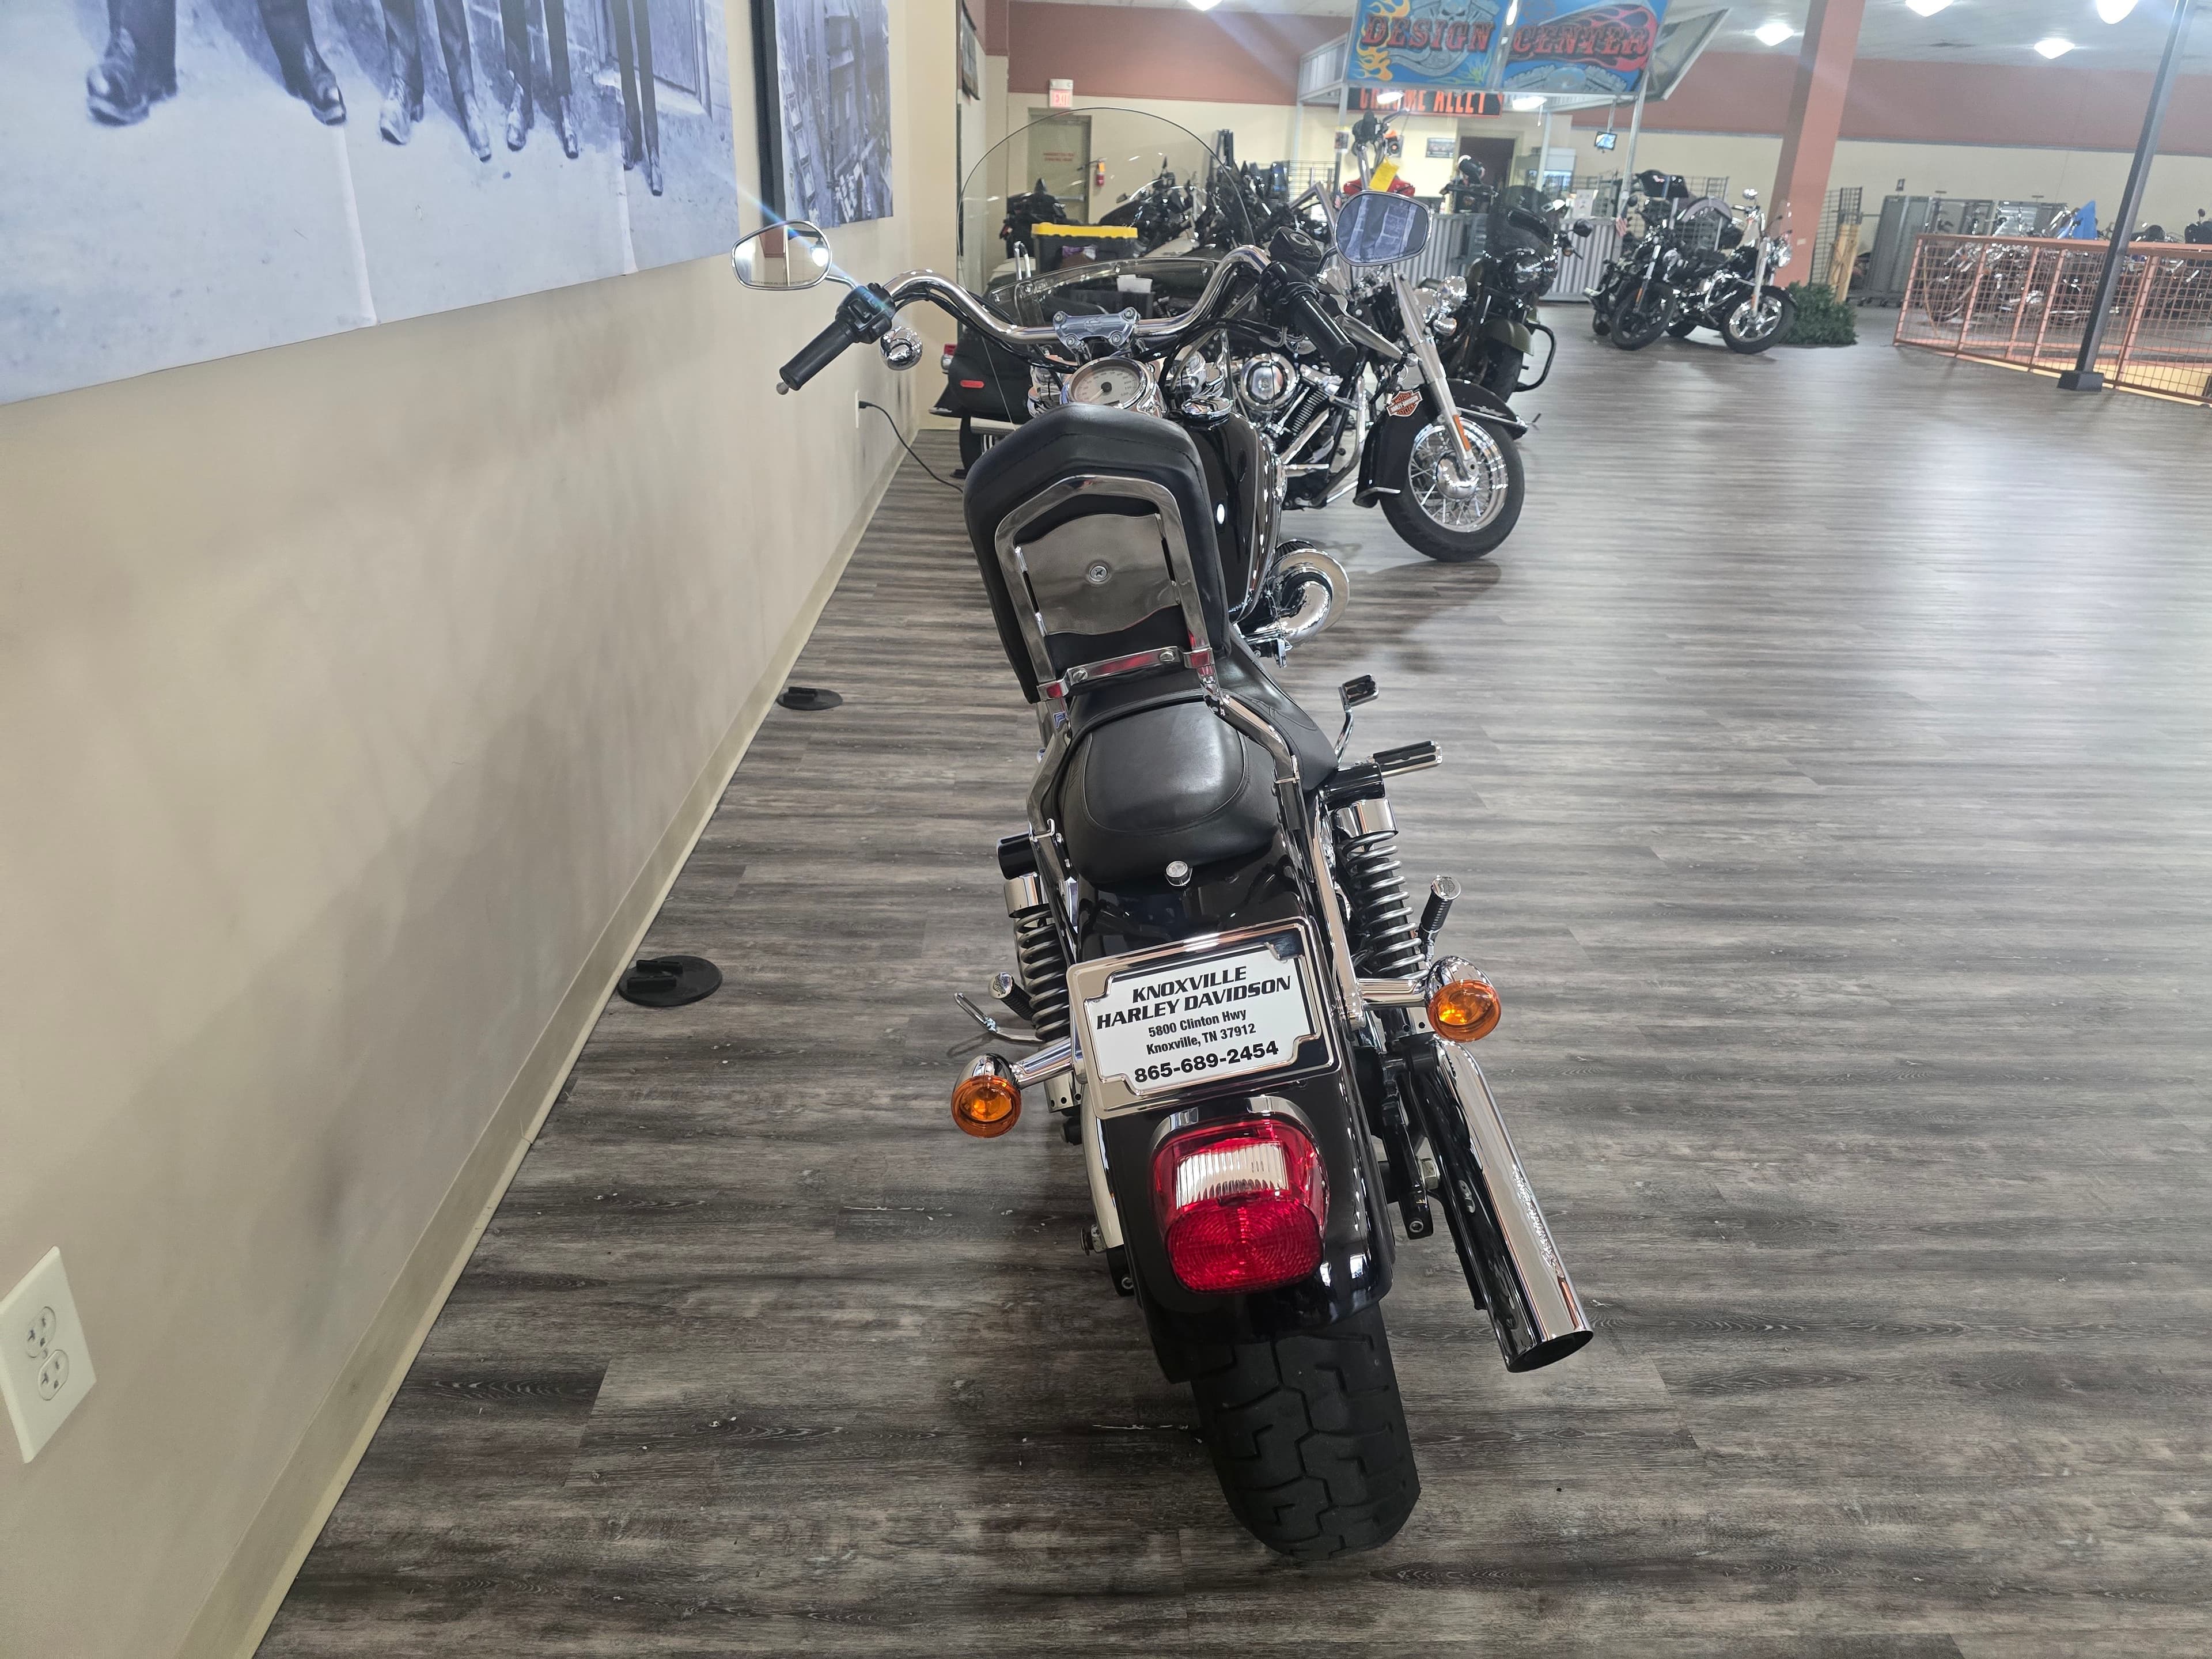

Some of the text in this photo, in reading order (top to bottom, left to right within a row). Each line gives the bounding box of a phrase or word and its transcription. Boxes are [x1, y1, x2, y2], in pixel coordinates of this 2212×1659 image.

[1362, 14, 1649, 56] DESIGN CENTER
[1054, 92, 1070, 106] EXIT
[1097, 975, 1291, 1029] HARLEY DAVIDSON
[1132, 965, 1247, 1003] KNOXVILLE
[1146, 1023, 1256, 1055] Knoxville, TN 37912
[1148, 1009, 1247, 1037] 5800 Clinton Hwy
[1134, 1040, 1279, 1083] 865-689-2454
